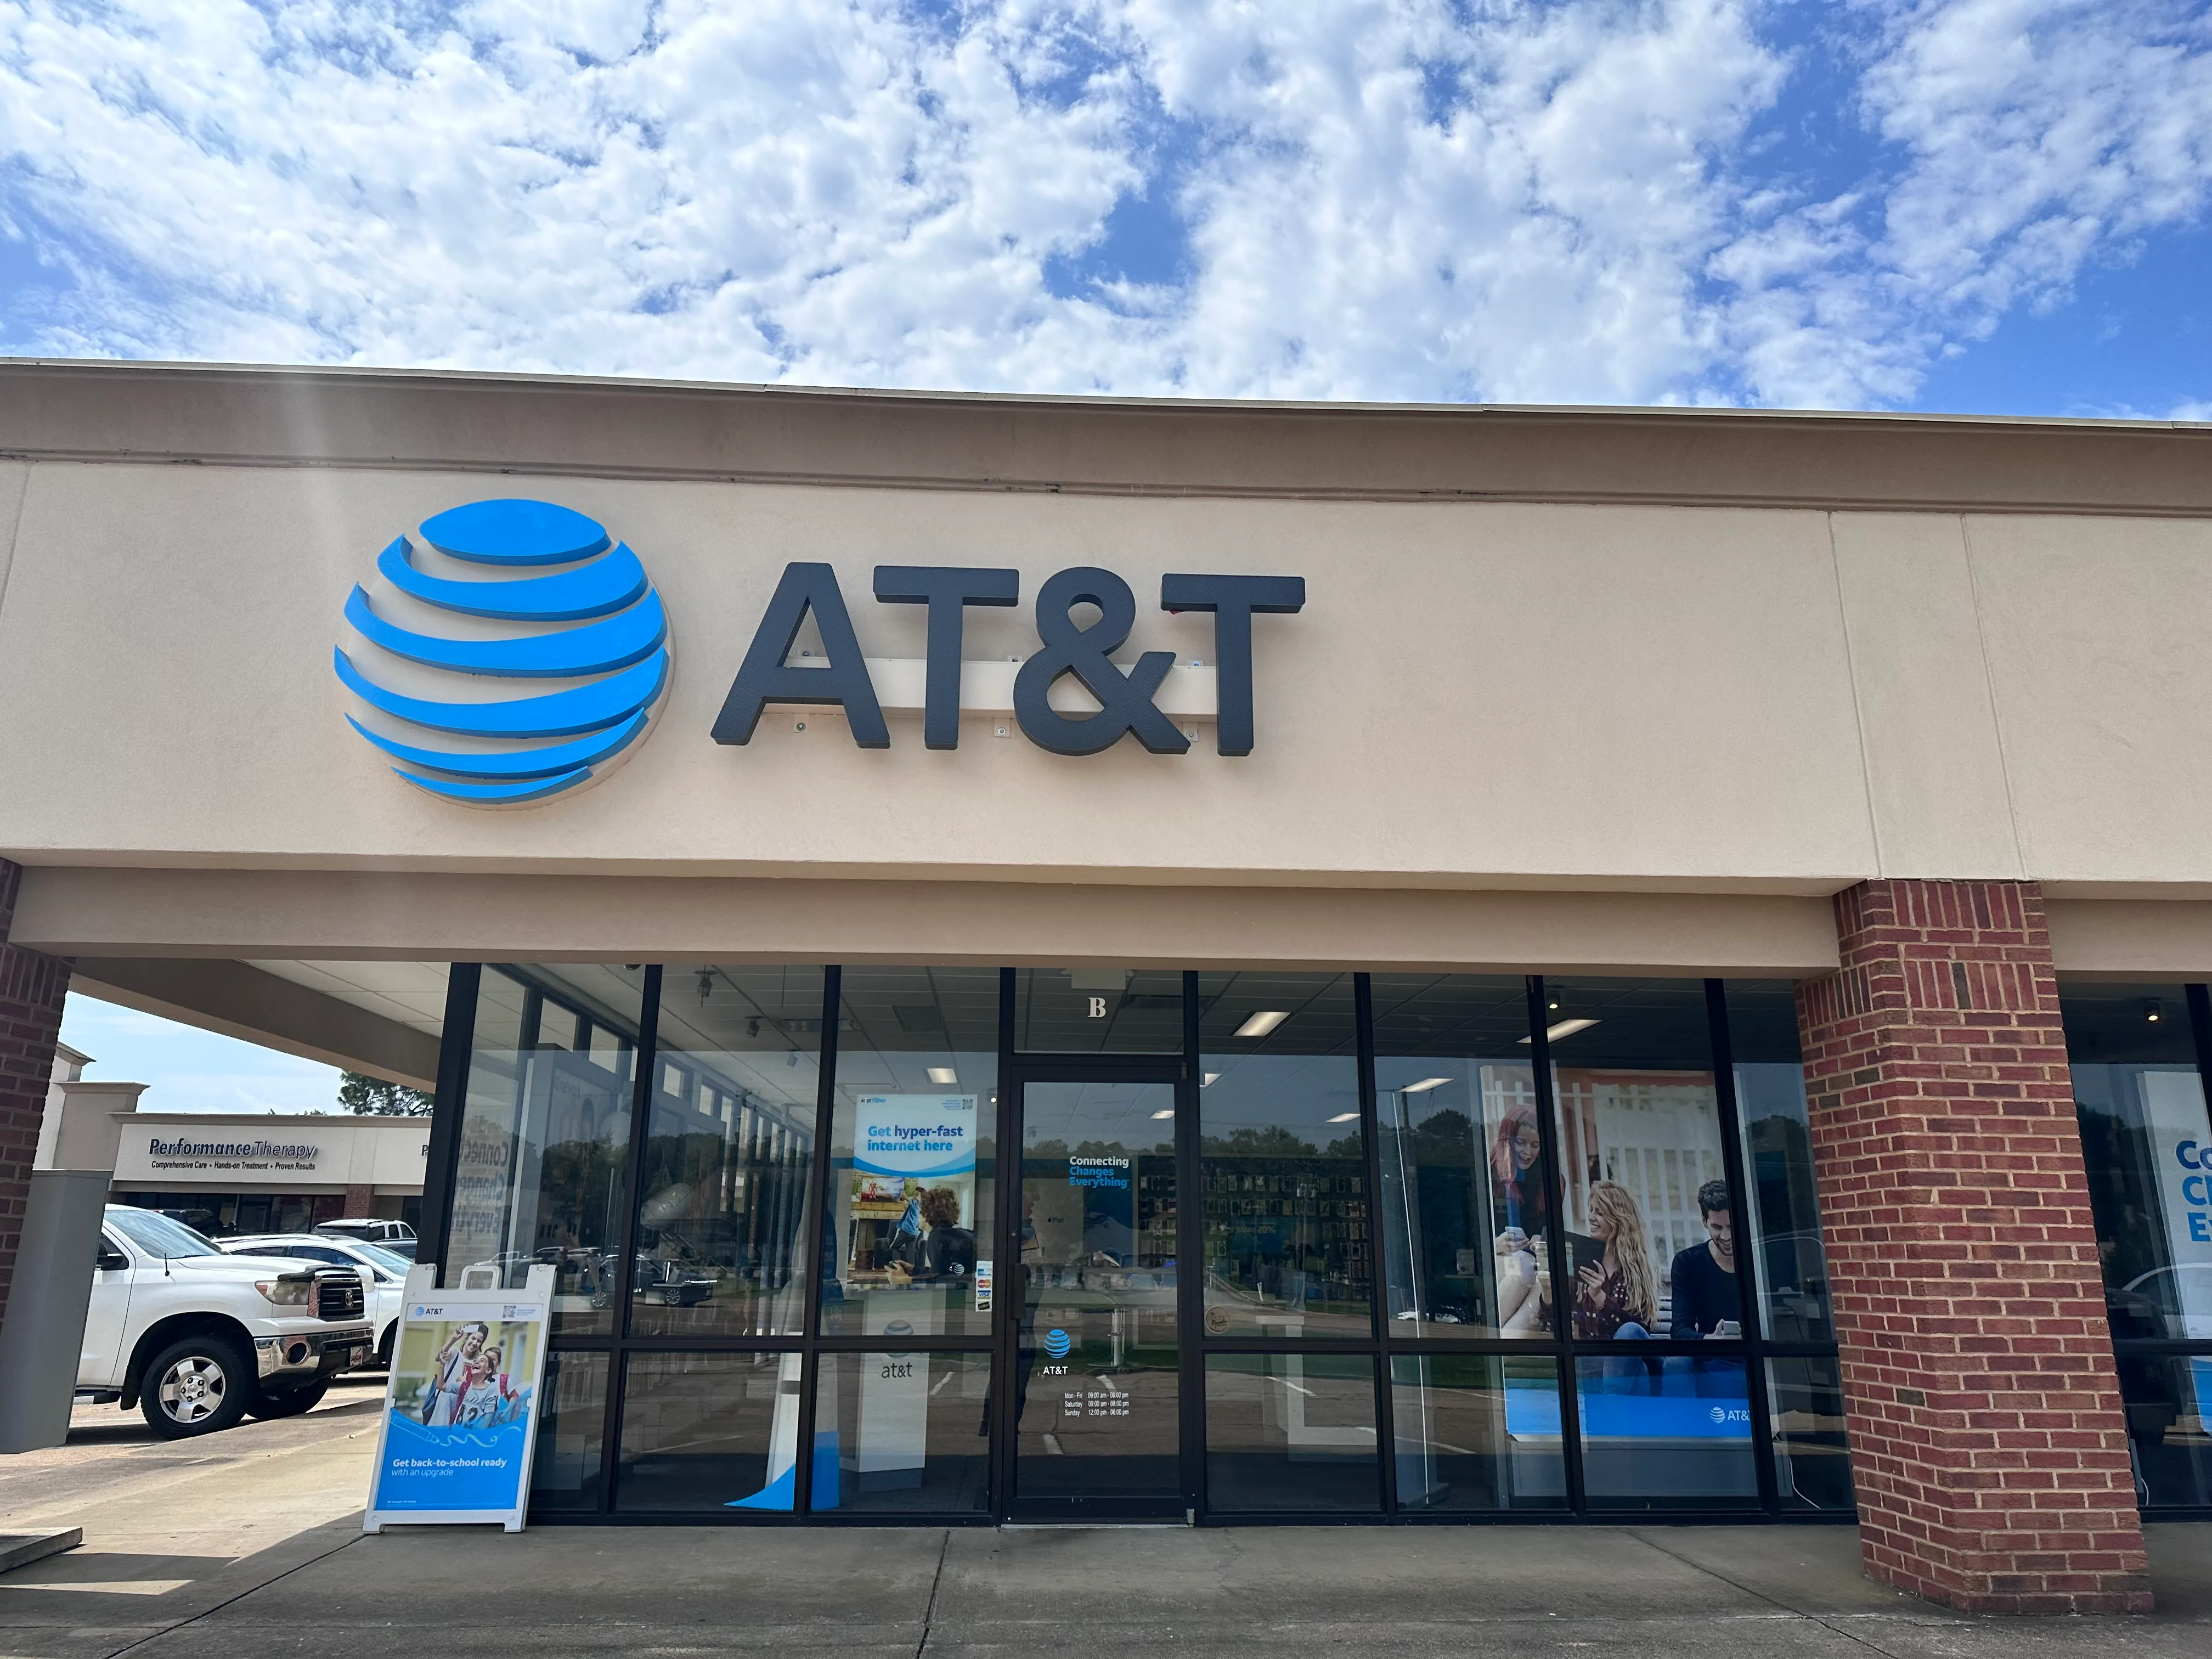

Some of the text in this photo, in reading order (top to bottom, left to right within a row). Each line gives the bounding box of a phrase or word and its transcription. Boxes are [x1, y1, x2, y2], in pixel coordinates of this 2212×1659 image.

[710, 562, 1305, 757] AT&T
[1087, 997, 1106, 1018] B
[868, 1125, 963, 1139] Get hyper-fast
[149, 1138, 316, 1159] Performance Therapy
[867, 1139, 953, 1151] internet here
[151, 1160, 193, 1170] Comprehensive
[194, 1161, 207, 1169] Care
[214, 1161, 240, 1170] Hands-on
[241, 1161, 268, 1170] Treatment
[275, 1162, 294, 1170] Proven
[1069, 1156, 1129, 1169] Connecting
[1069, 1166, 1114, 1178] Changes
[1069, 1176, 1127, 1189] Everything
[2187, 1212, 2212, 1242] E
[881, 1362, 913, 1378] at&t
[1043, 1366, 1068, 1375] AT&T
[1728, 1410, 1750, 1421] AT&
[393, 1458, 507, 1469] Get back-to-school ready
[421, 1468, 454, 1477] upgrade
